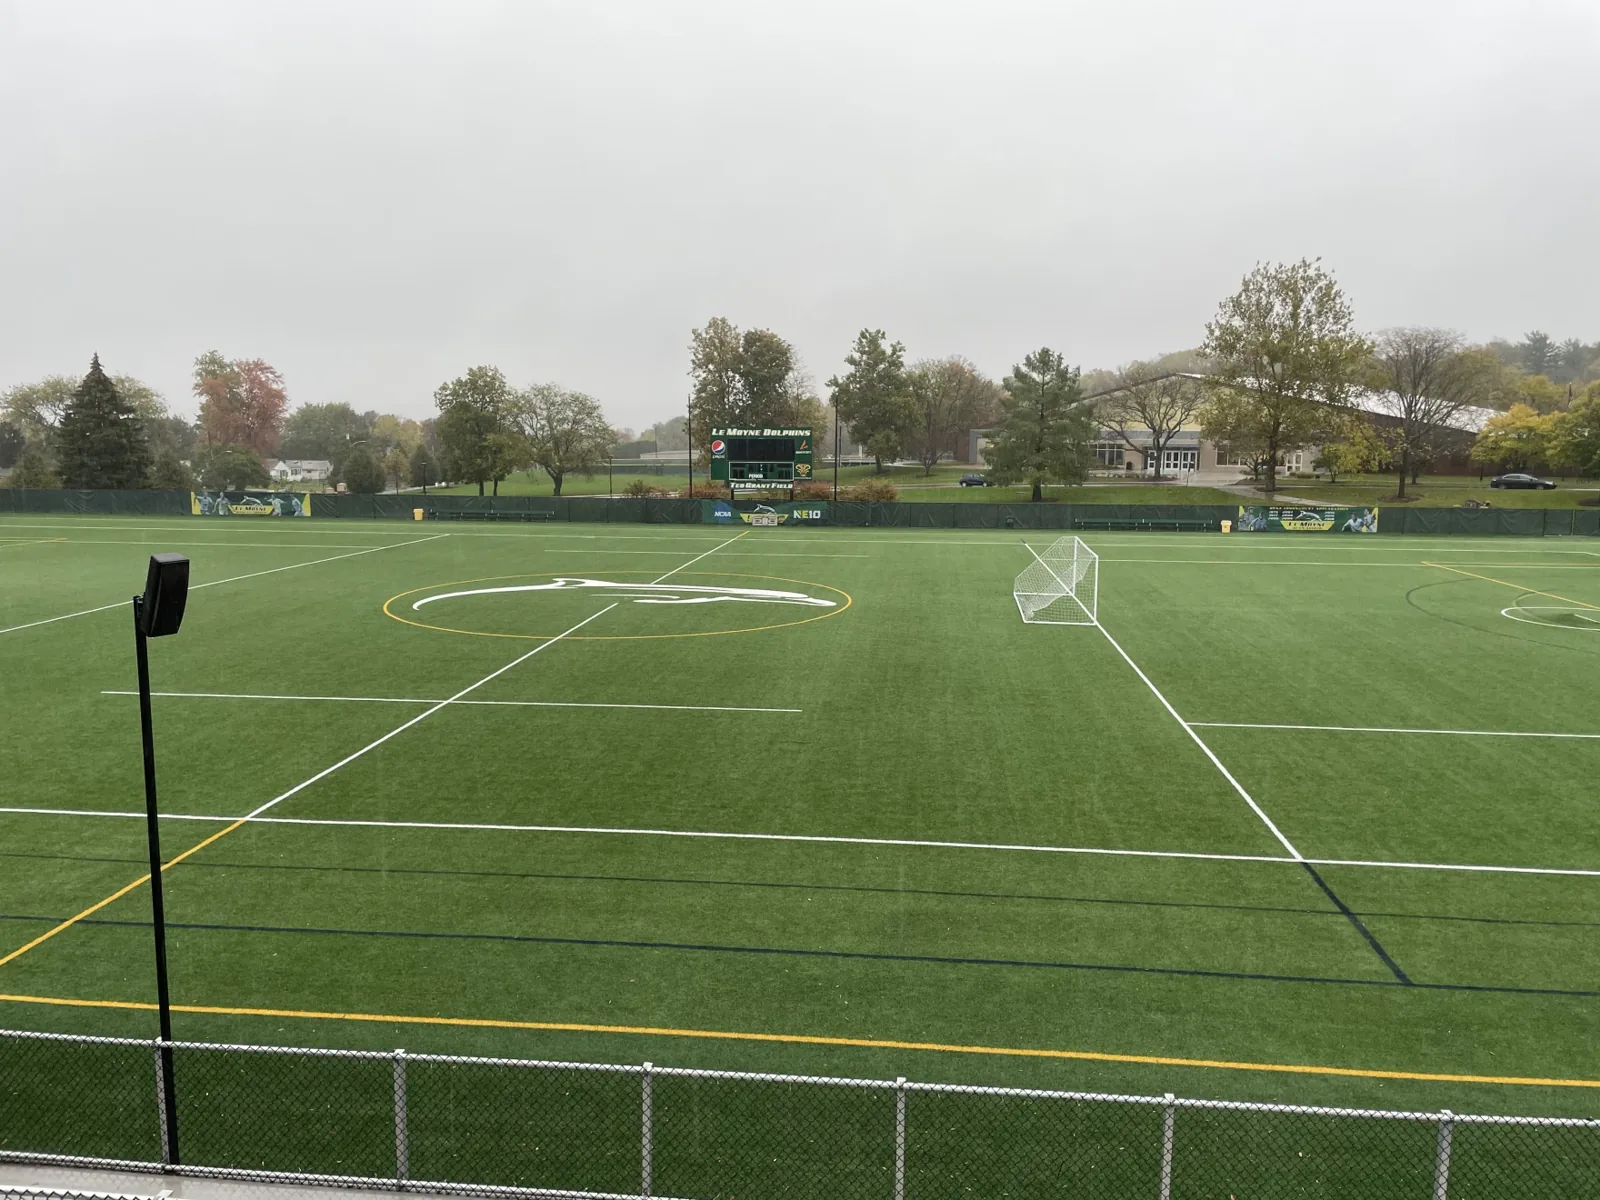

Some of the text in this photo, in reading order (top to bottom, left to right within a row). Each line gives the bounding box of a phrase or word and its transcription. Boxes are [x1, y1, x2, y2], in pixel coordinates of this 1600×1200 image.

[712, 428, 725, 436] LE
[726, 428, 761, 436] MOYNE
[793, 510, 821, 519] NE10
